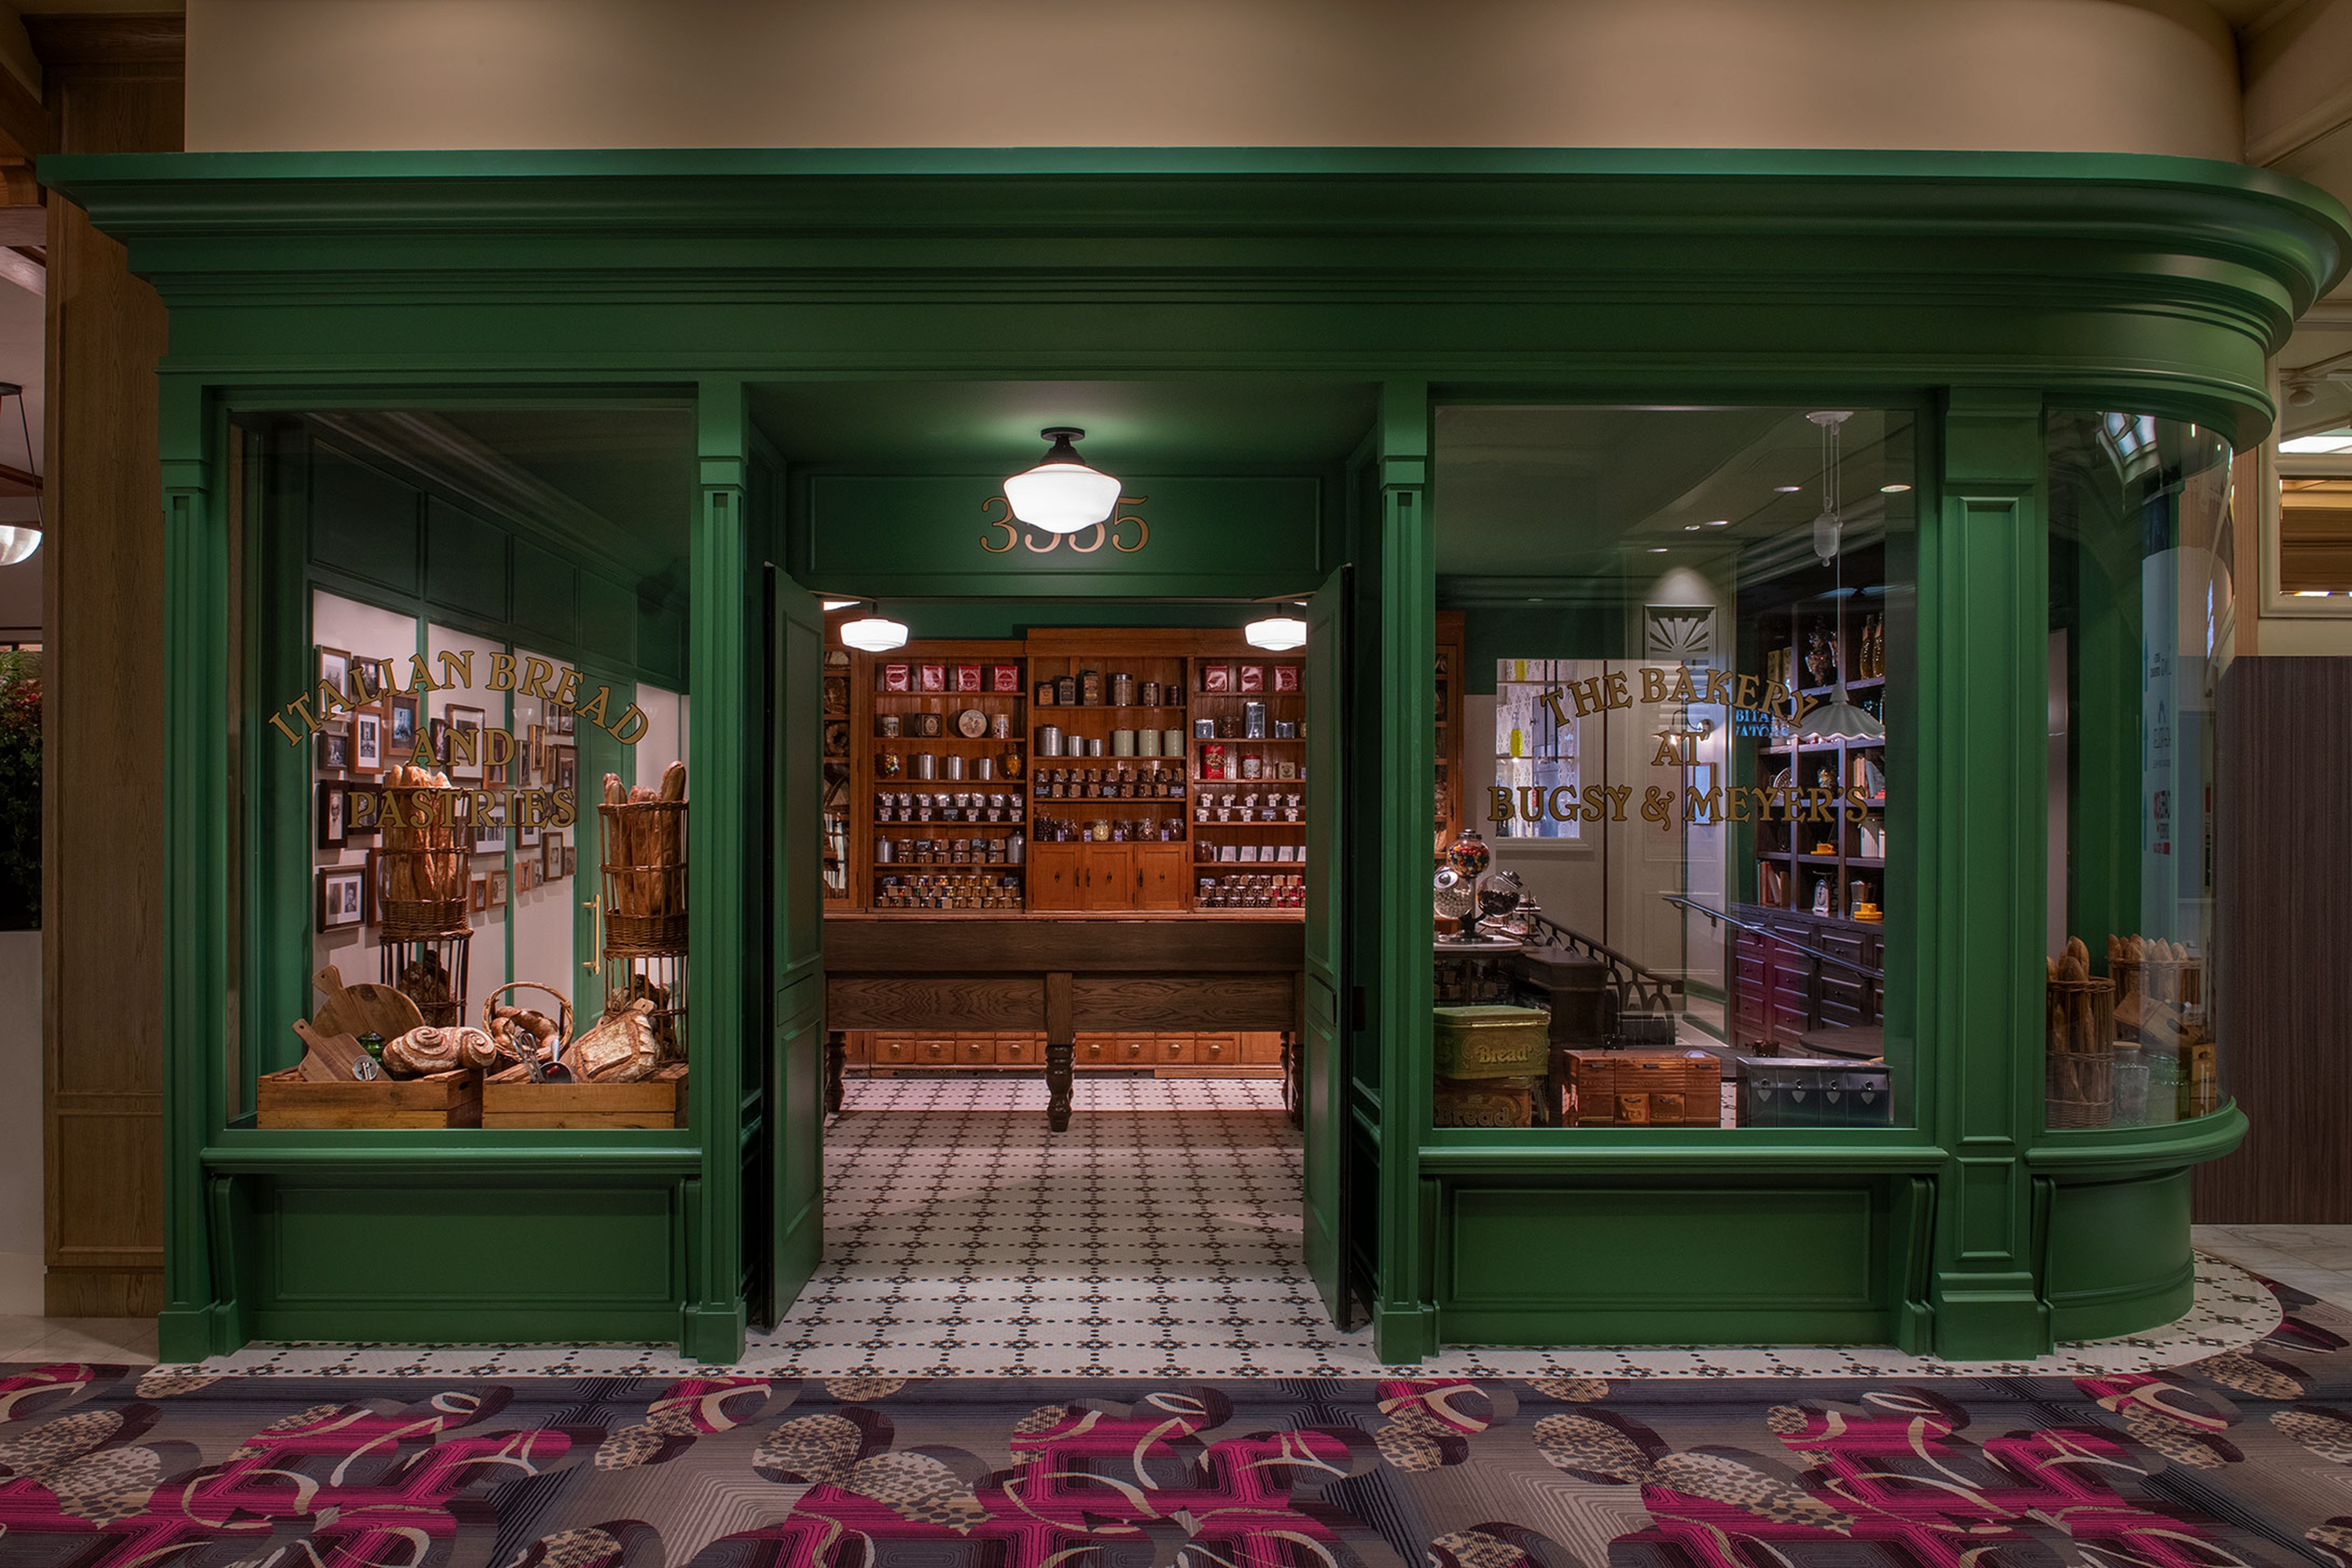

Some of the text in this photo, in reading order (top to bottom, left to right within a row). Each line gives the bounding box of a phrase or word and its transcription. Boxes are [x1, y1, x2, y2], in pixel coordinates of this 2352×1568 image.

[268, 650, 649, 748] ITALIAN BREAD
[1541, 666, 1818, 728] THE BAKERY
[407, 727, 517, 768] AND
[1650, 728, 1708, 767] AT
[347, 786, 577, 829] PASTRIES
[1486, 784, 1869, 832] BUGSY & MEYER'S
[1474, 1044, 1534, 1065] Bread
[1435, 1104, 1512, 1127] Bread
